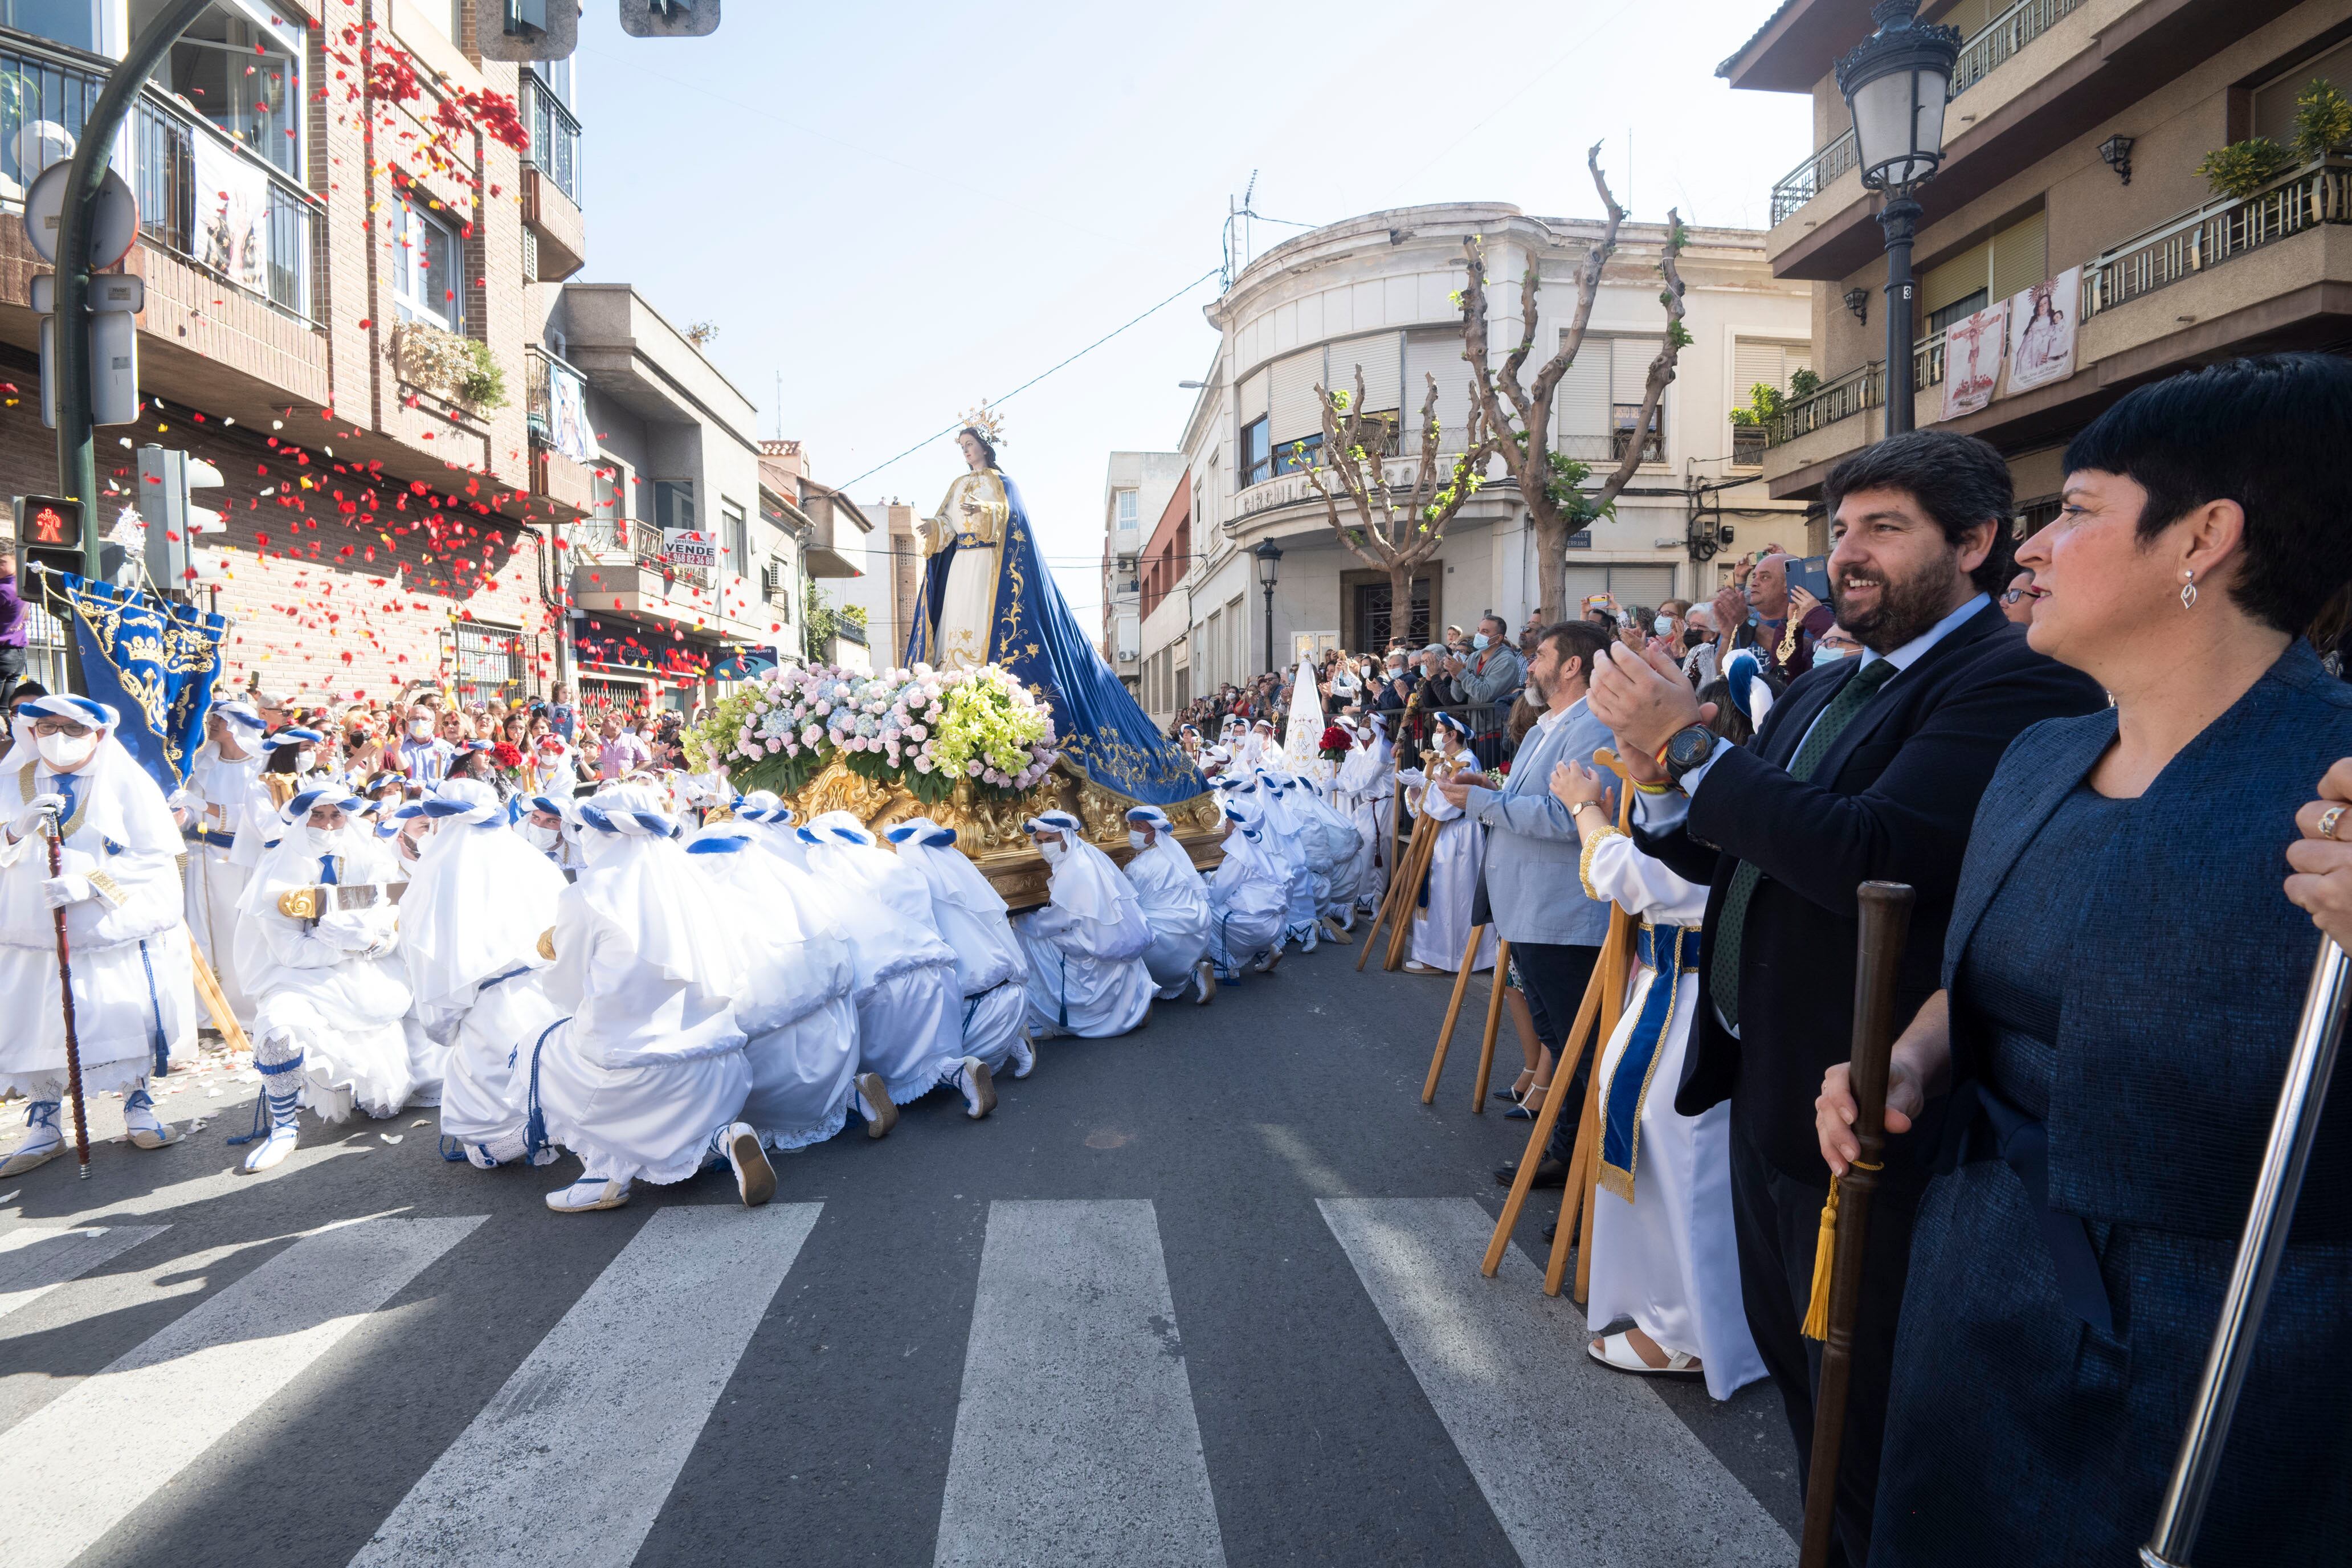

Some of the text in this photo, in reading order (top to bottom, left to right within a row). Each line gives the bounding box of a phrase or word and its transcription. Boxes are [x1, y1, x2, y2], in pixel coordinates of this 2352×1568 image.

[1905, 288, 1910, 297] 3
[1243, 464, 1451, 514] CIRCULO AGCOA
[665, 543, 714, 556] VENDE
[673, 553, 685, 563] 968
[687, 554, 695, 564] 82
[696, 556, 704, 565] 36
[705, 557, 714, 565] 80
[1758, 656, 1771, 667] CE
